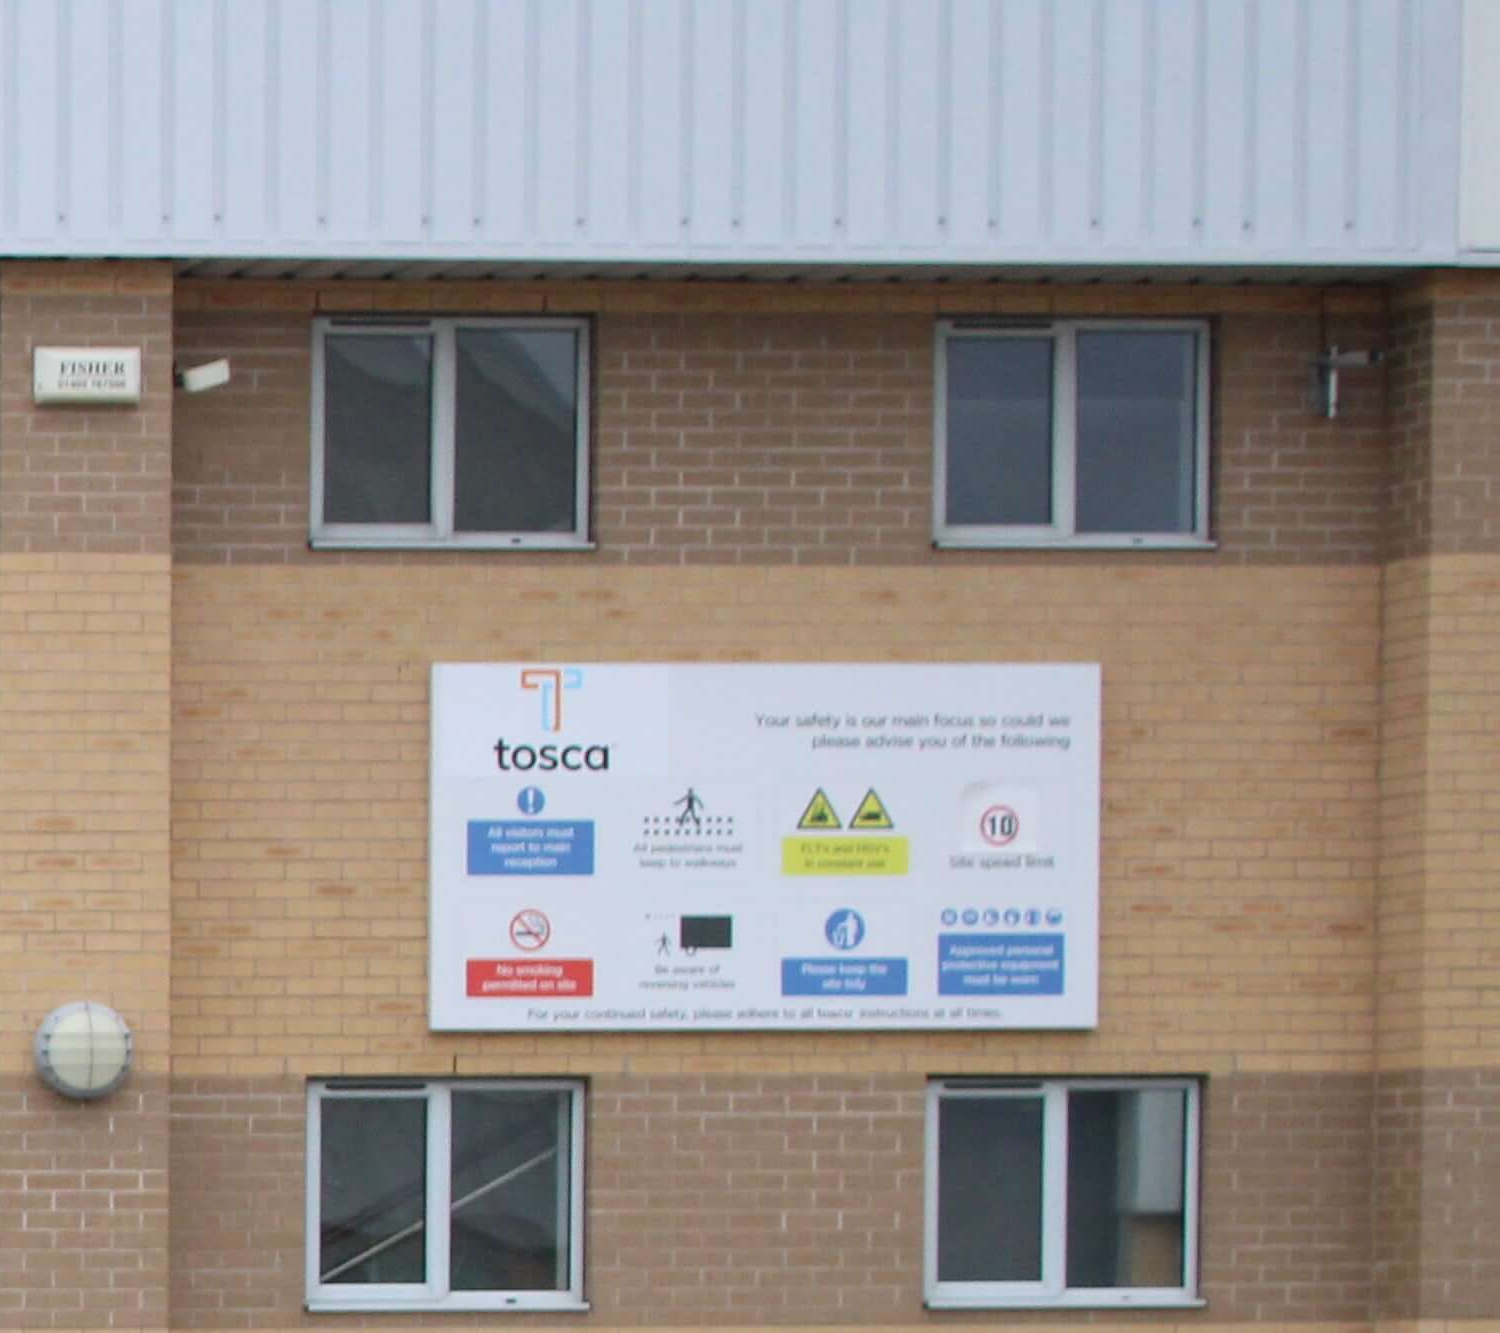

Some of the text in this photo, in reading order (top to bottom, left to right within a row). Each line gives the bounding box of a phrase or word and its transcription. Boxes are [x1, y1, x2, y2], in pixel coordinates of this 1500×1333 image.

[60, 361, 125, 375] FISHER
[755, 714, 1070, 730] Your safety is our main focus so could we
[812, 734, 1070, 750] please advise you of the following
[493, 737, 609, 771] tosca
[988, 815, 1014, 837] 10
